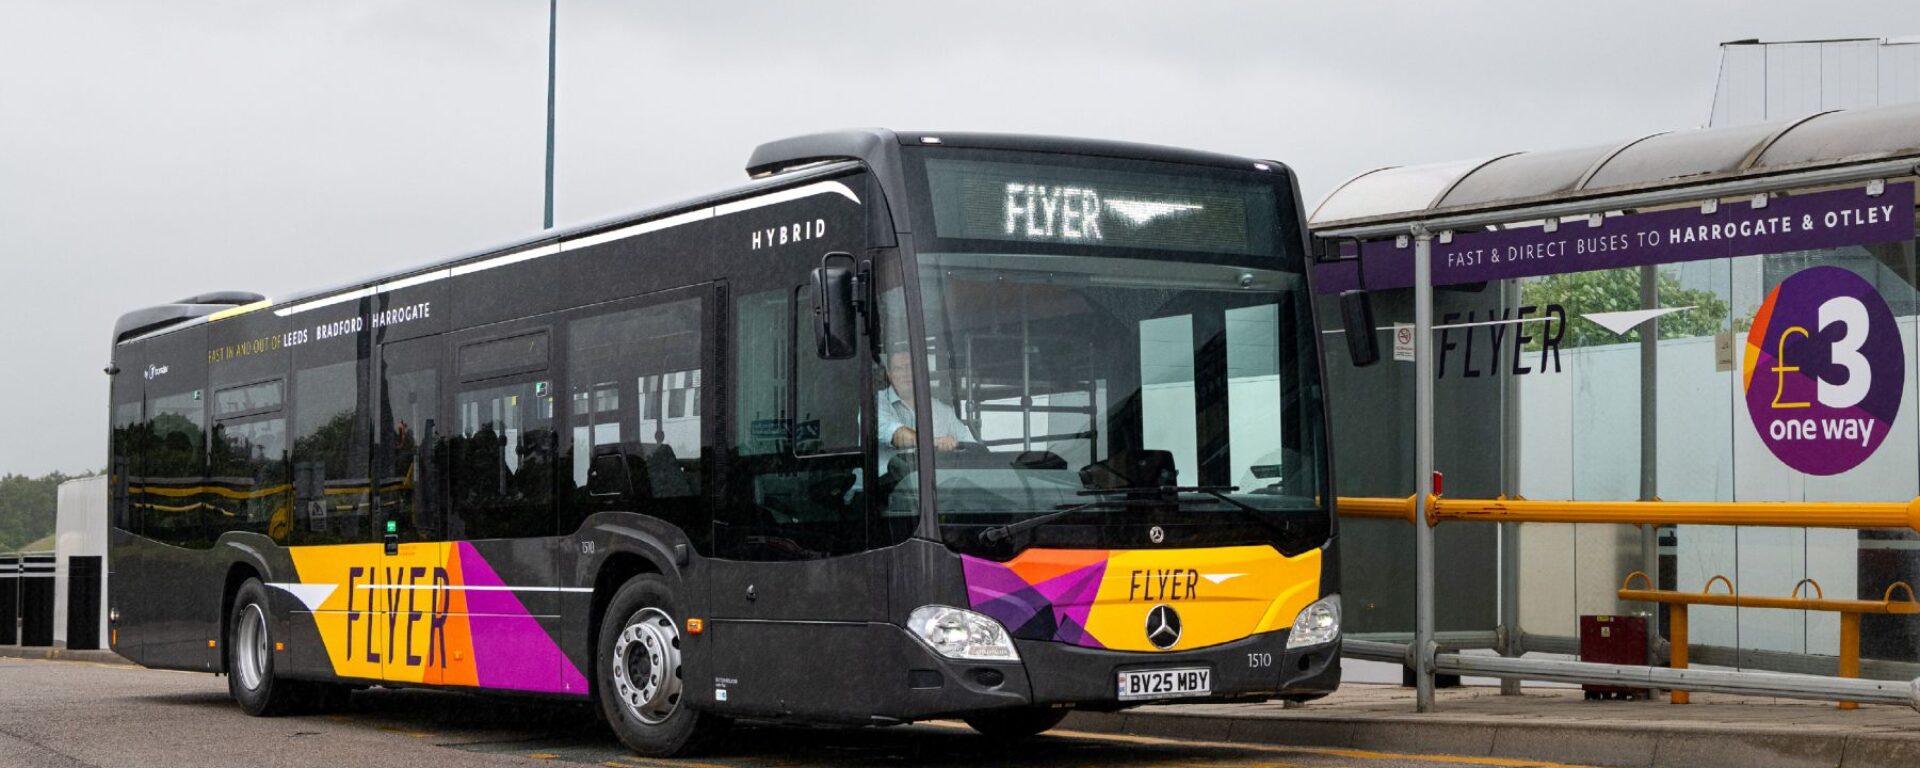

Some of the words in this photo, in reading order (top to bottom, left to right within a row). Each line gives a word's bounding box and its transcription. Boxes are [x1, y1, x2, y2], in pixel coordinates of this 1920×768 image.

[752, 218, 826, 250] HYBRID
[1005, 183, 1103, 239] FLYER
[1448, 250, 1483, 268] FAST
[1491, 248, 1500, 263] &
[1508, 241, 1566, 262] DIRECT
[1577, 234, 1628, 254] BUSES
[1637, 230, 1660, 248] TO
[1669, 216, 1791, 244] HARROGATE
[1802, 214, 1814, 231] &
[1824, 205, 1894, 228] OTLEY
[208, 350, 223, 363] FAST
[253, 338, 269, 354] OUT
[271, 336, 281, 350] OF
[283, 329, 308, 348] LEEDS
[316, 317, 363, 341] BRADFORD
[372, 302, 430, 329] HARROGATE
[1438, 303, 1566, 380] FLYER
[1771, 296, 1872, 409] £3
[1769, 418, 1817, 440] one
[1821, 418, 1875, 447] way
[1129, 569, 1199, 601] FLYER
[346, 566, 450, 669] FLYER
[1130, 673, 1173, 694] BV25
[1177, 671, 1208, 692] MBY
[1247, 653, 1272, 668] 1510
